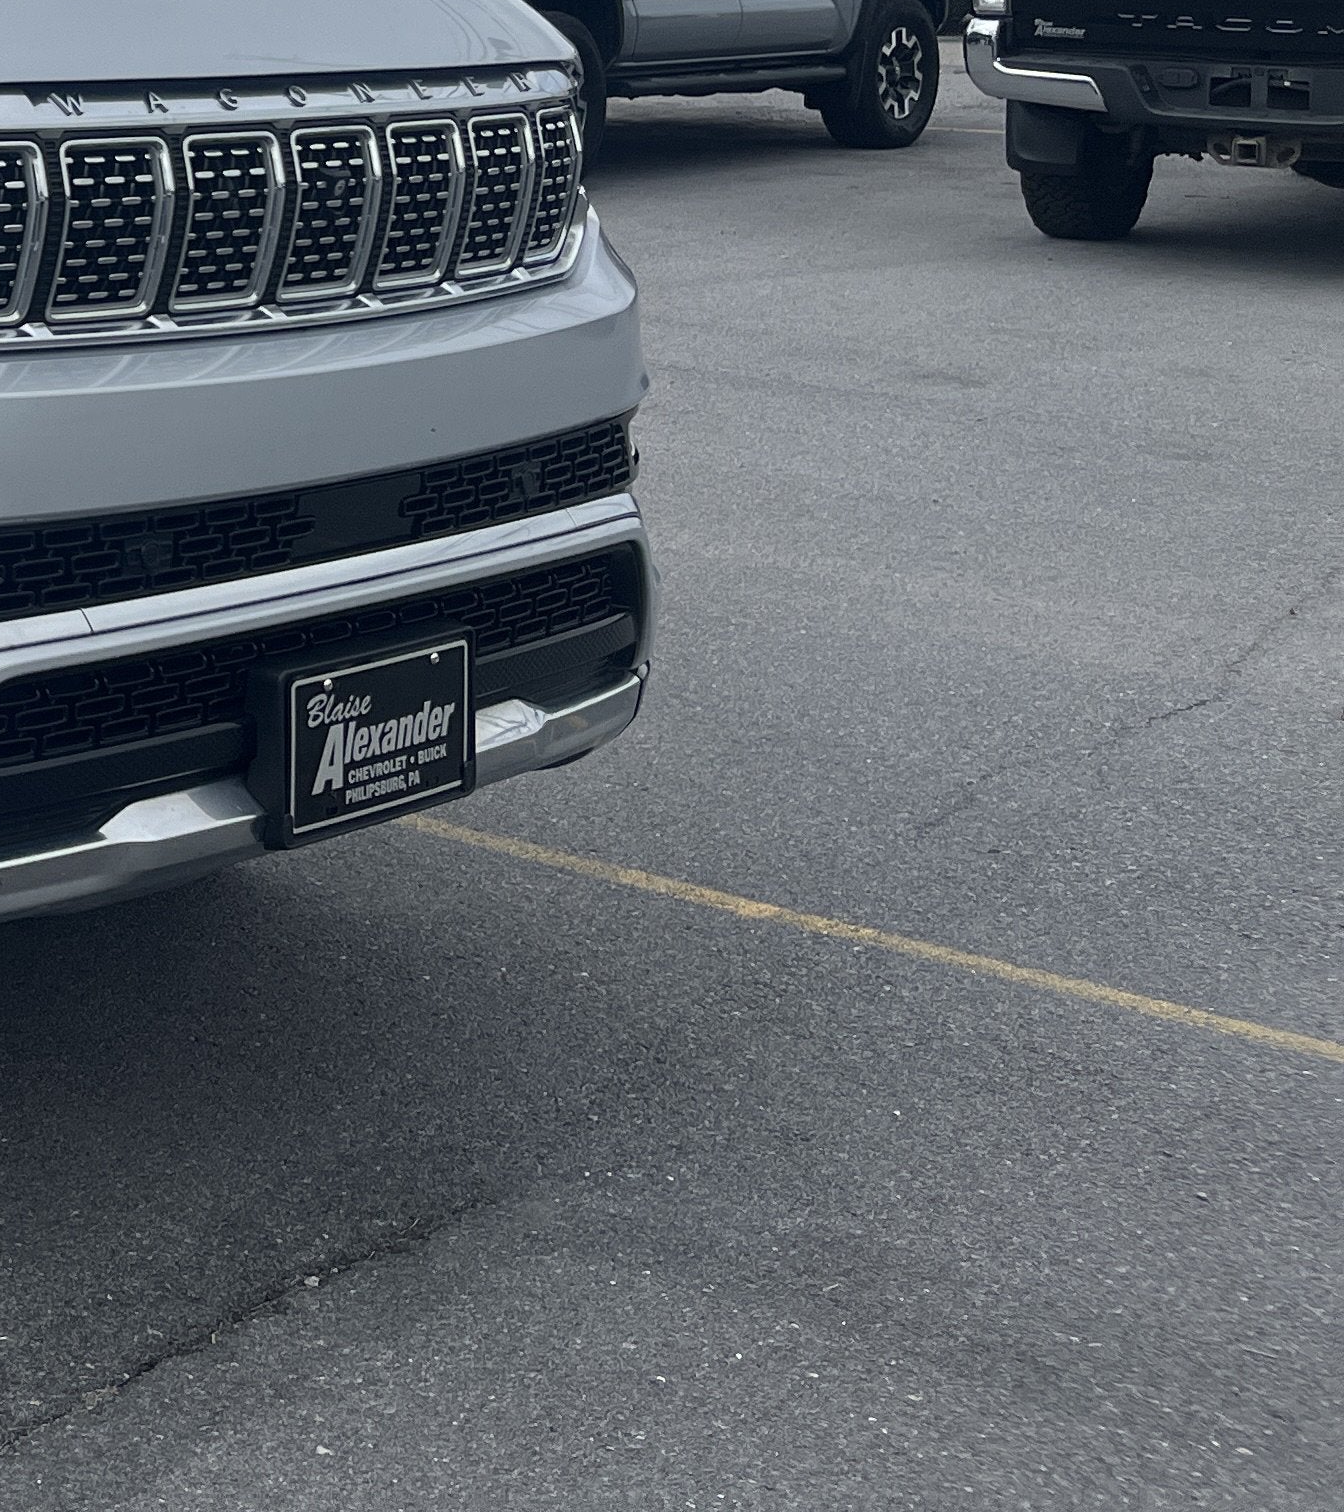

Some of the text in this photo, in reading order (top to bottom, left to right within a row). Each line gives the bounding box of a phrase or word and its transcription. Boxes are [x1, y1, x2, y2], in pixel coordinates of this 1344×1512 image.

[48, 71, 534, 117] WAGONEER
[307, 694, 372, 728] Blaise
[312, 701, 456, 796] Alexander
[348, 743, 447, 784] CHEVROLET BUICK
[408, 770, 421, 787] PA
